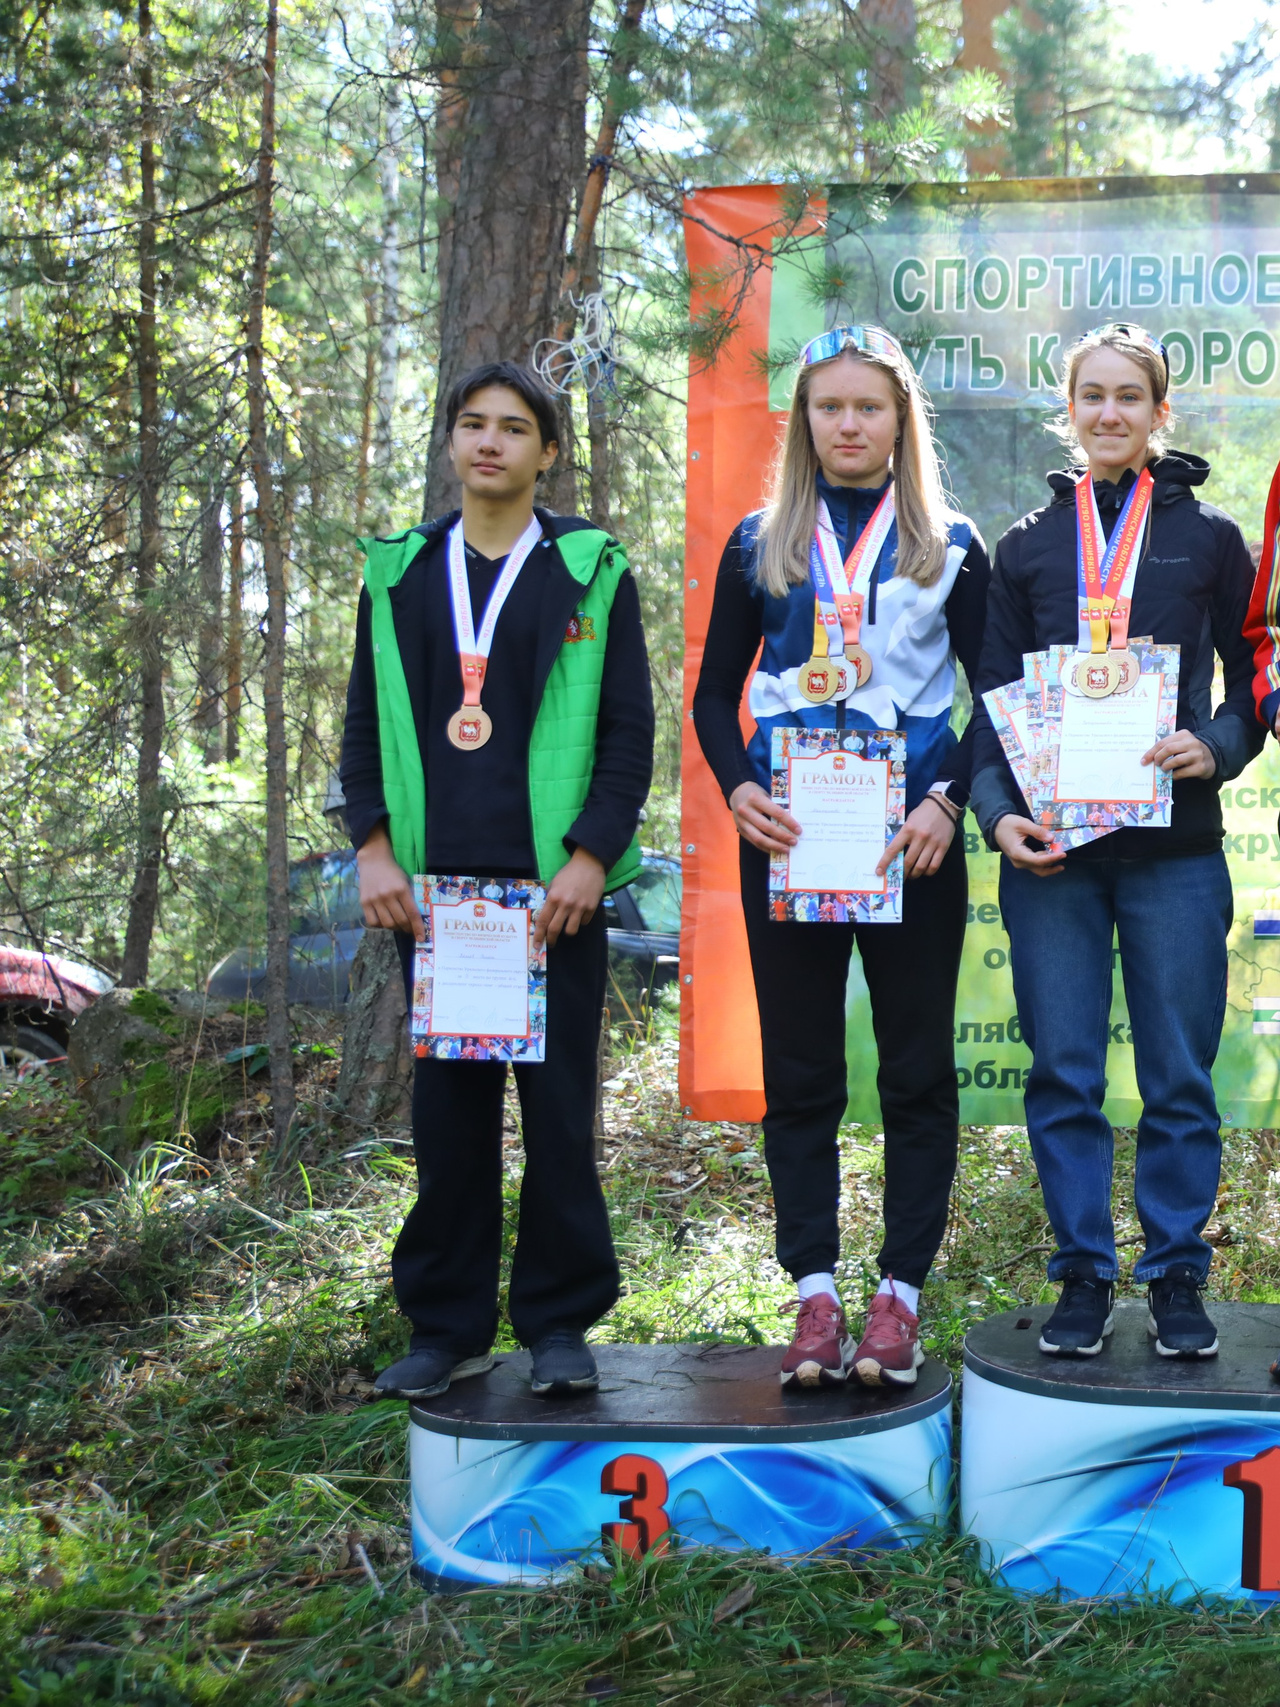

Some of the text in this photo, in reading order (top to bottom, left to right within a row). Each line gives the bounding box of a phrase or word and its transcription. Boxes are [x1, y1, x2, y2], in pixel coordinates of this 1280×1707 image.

[902, 334, 1005, 390] УТЬ
[1028, 333, 1061, 390] К
[1080, 485, 1090, 521] ОБЛАСТЬ
[1125, 485, 1148, 541] ЧЕЛЯБИНСКАЯ
[810, 540, 826, 588] ЧЕЛЯБИНСК
[845, 550, 863, 579] ОБЛАС
[1083, 522, 1096, 584] ЧЕЛЯБИНСКАЯ
[1112, 544, 1130, 583] ОБЛАСТЬ
[801, 772, 876, 786] ГРАМОТА
[444, 918, 517, 933] ГРАМОТА
[601, 1453, 671, 1560] 3
